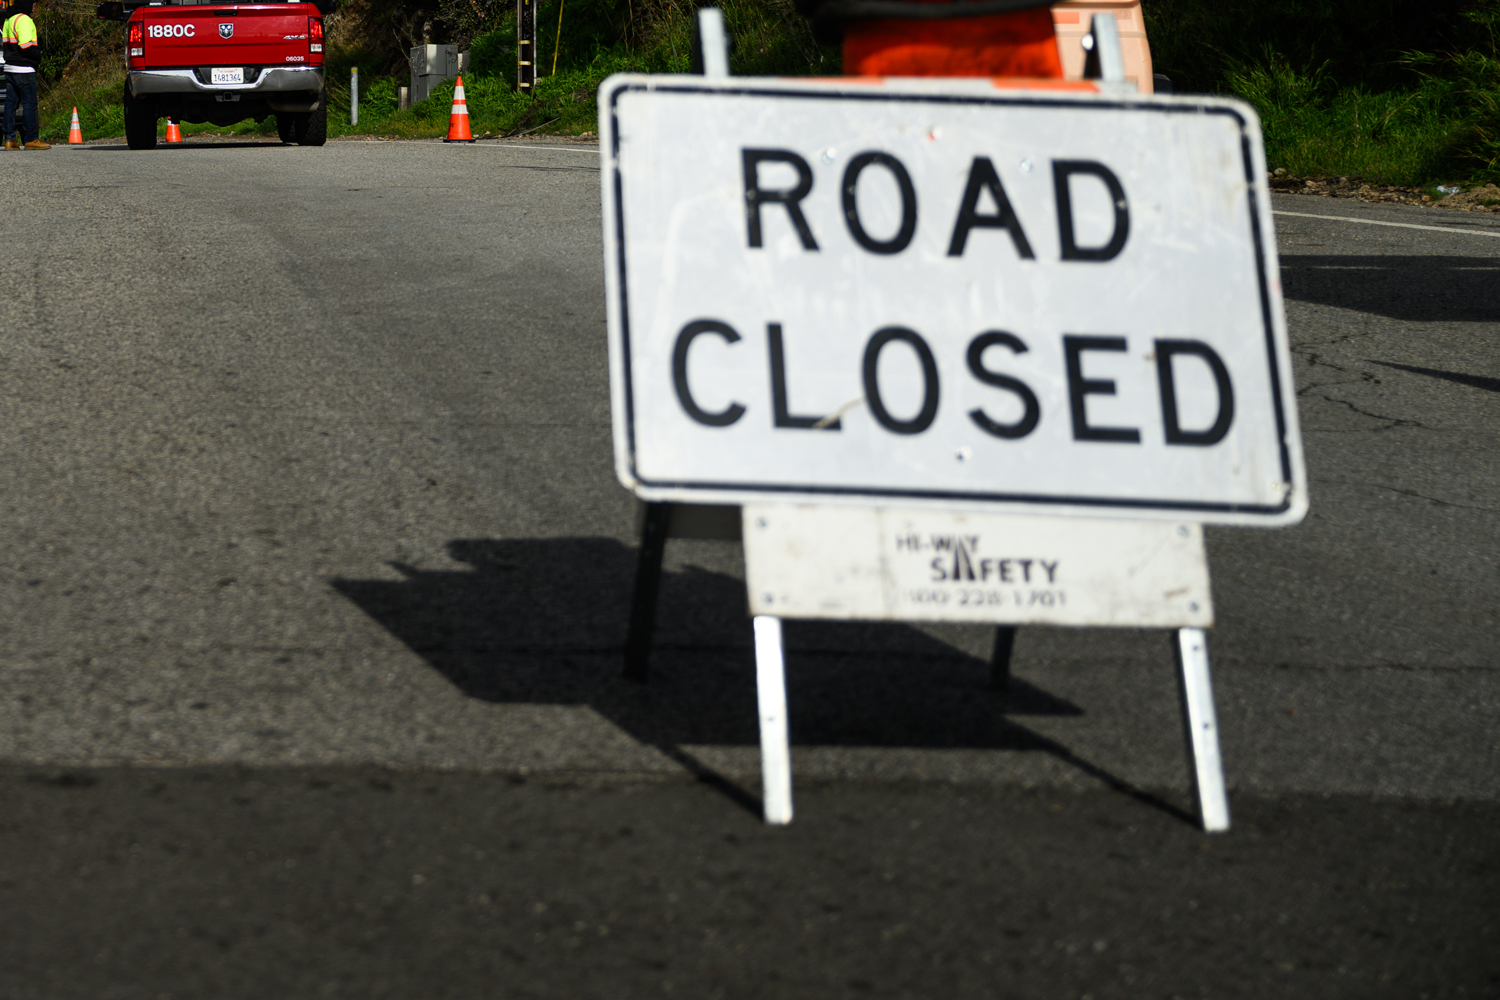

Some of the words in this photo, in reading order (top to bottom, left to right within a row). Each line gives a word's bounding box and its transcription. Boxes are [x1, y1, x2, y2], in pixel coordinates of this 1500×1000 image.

[147, 24, 196, 38] 1880C
[741, 147, 1131, 263] ROAD
[671, 318, 1236, 448] CLOSED
[930, 553, 1058, 583] SAFETY
